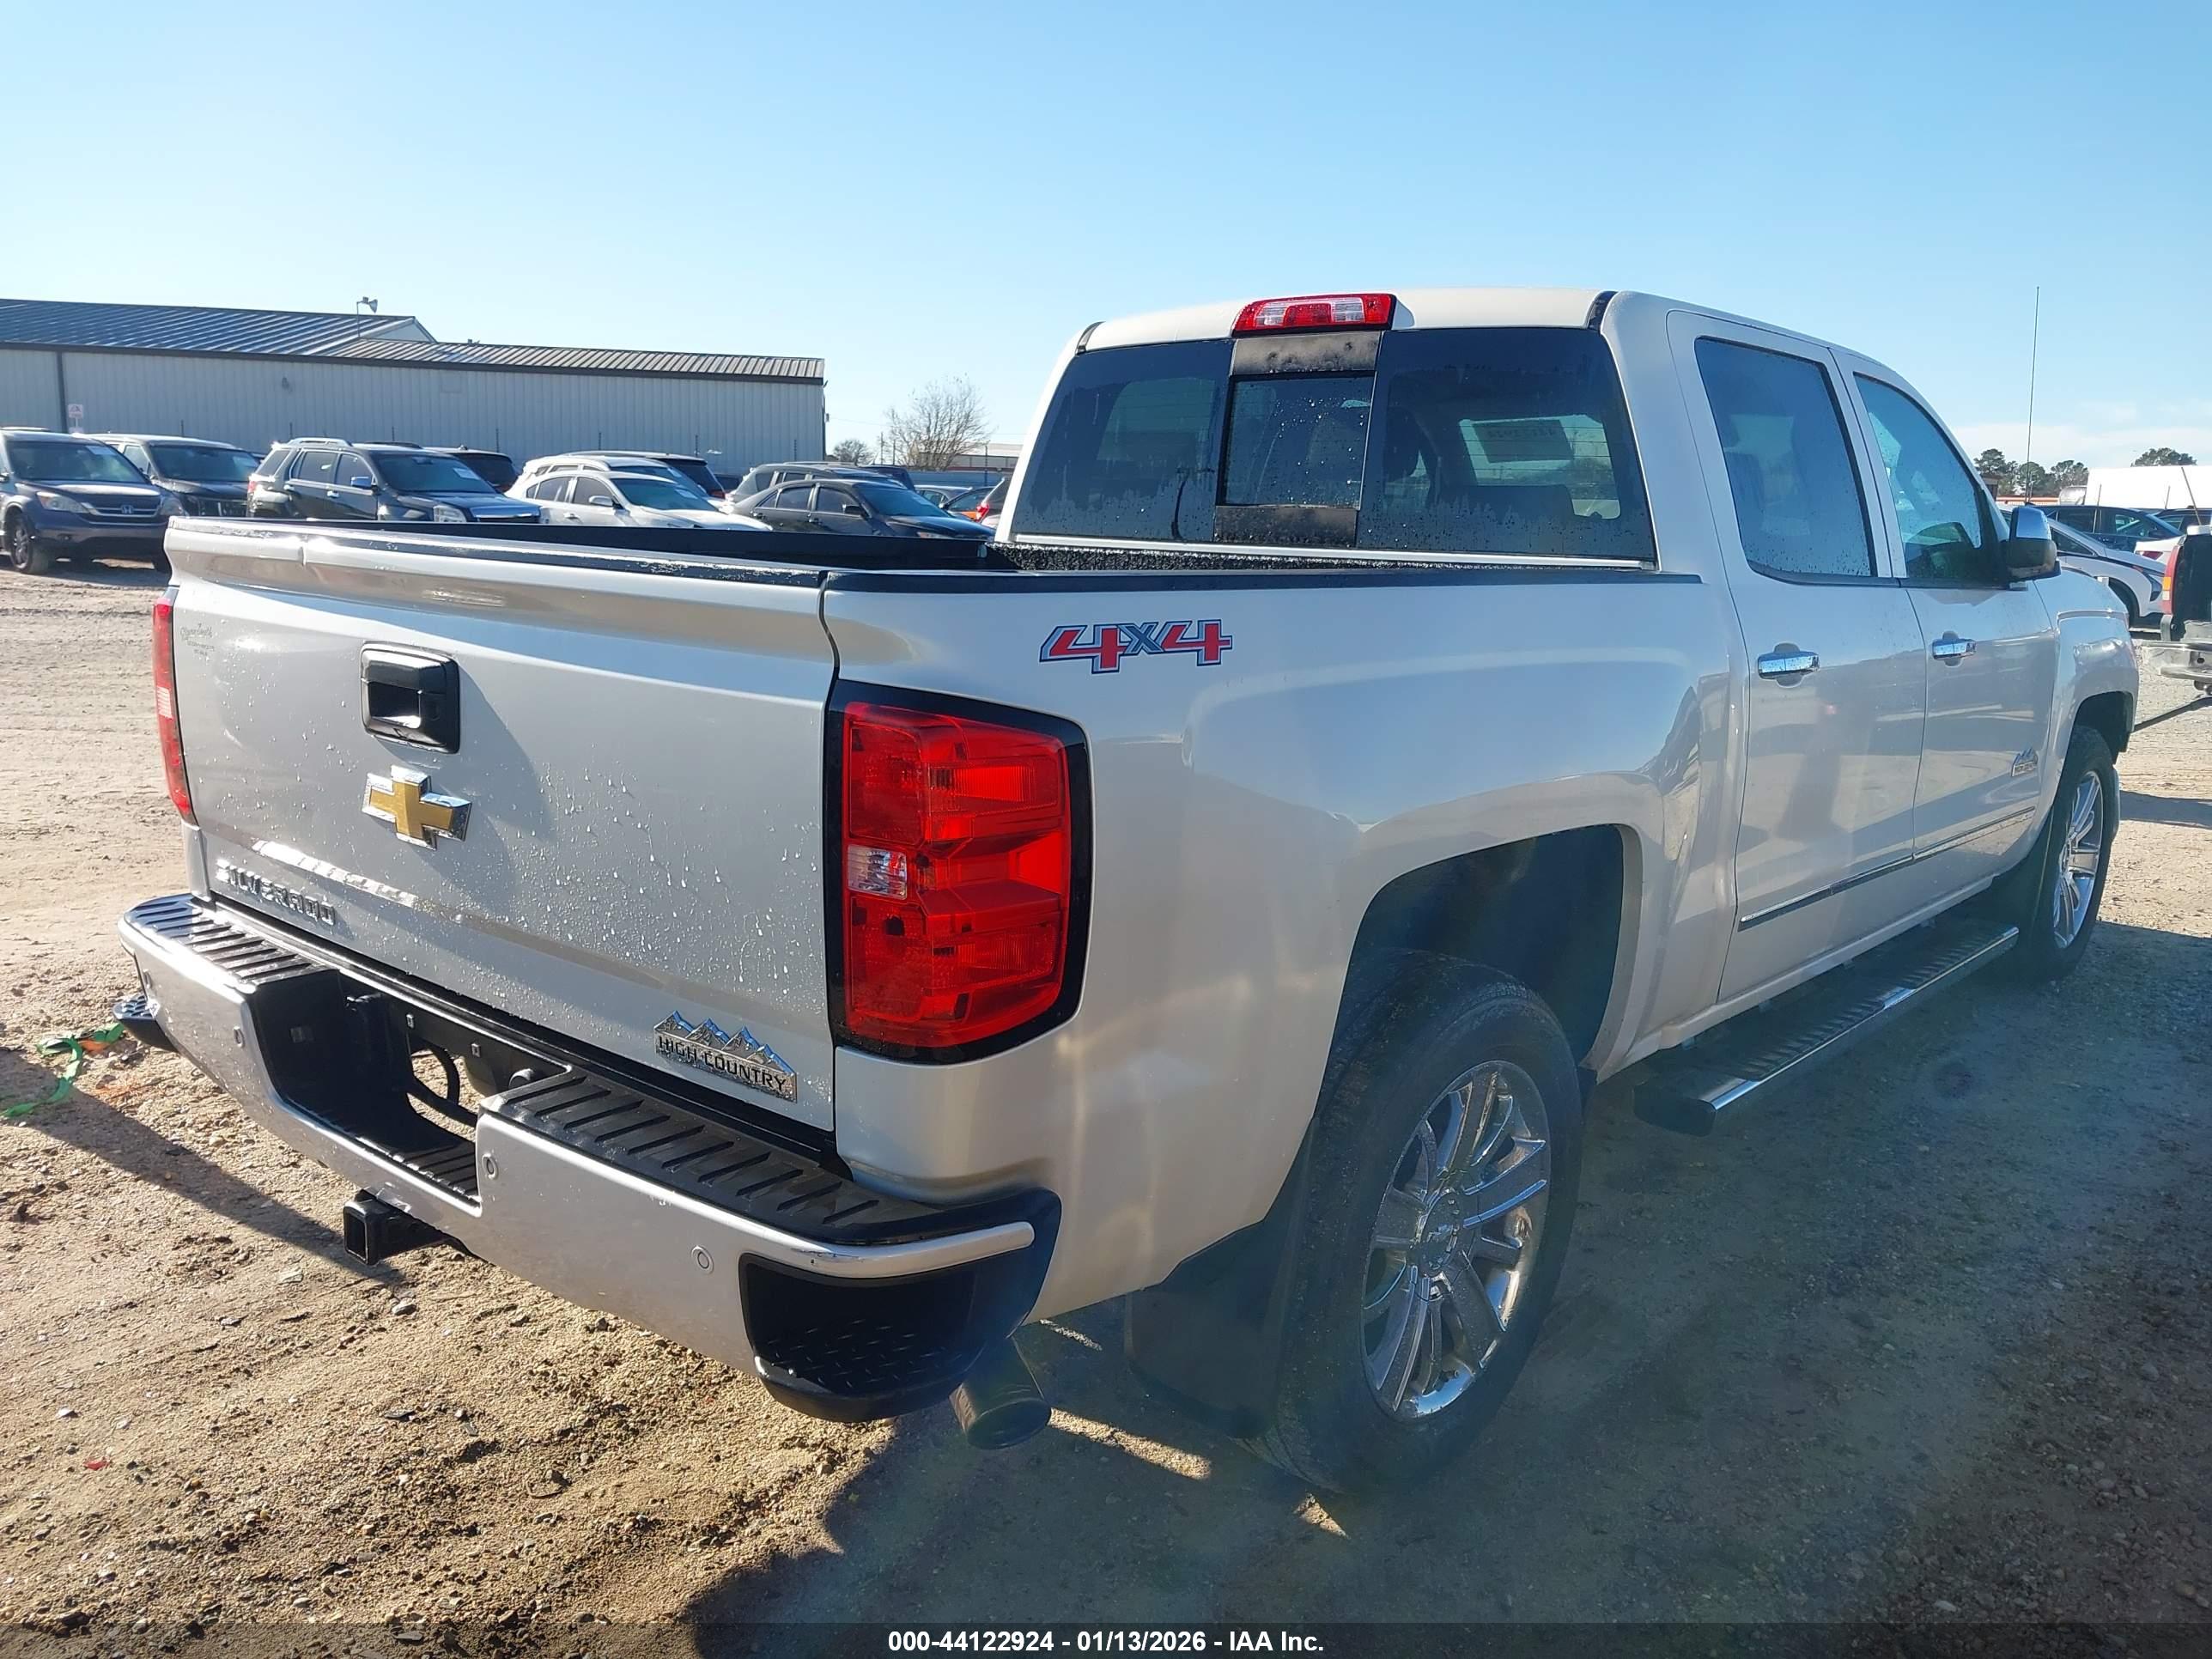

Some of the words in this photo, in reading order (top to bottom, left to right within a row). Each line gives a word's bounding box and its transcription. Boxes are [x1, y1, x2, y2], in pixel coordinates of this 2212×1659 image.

[216, 859, 336, 927] SILVERADO
[658, 1035, 697, 1061] HIGH
[704, 1050, 787, 1092] COUNTRY
